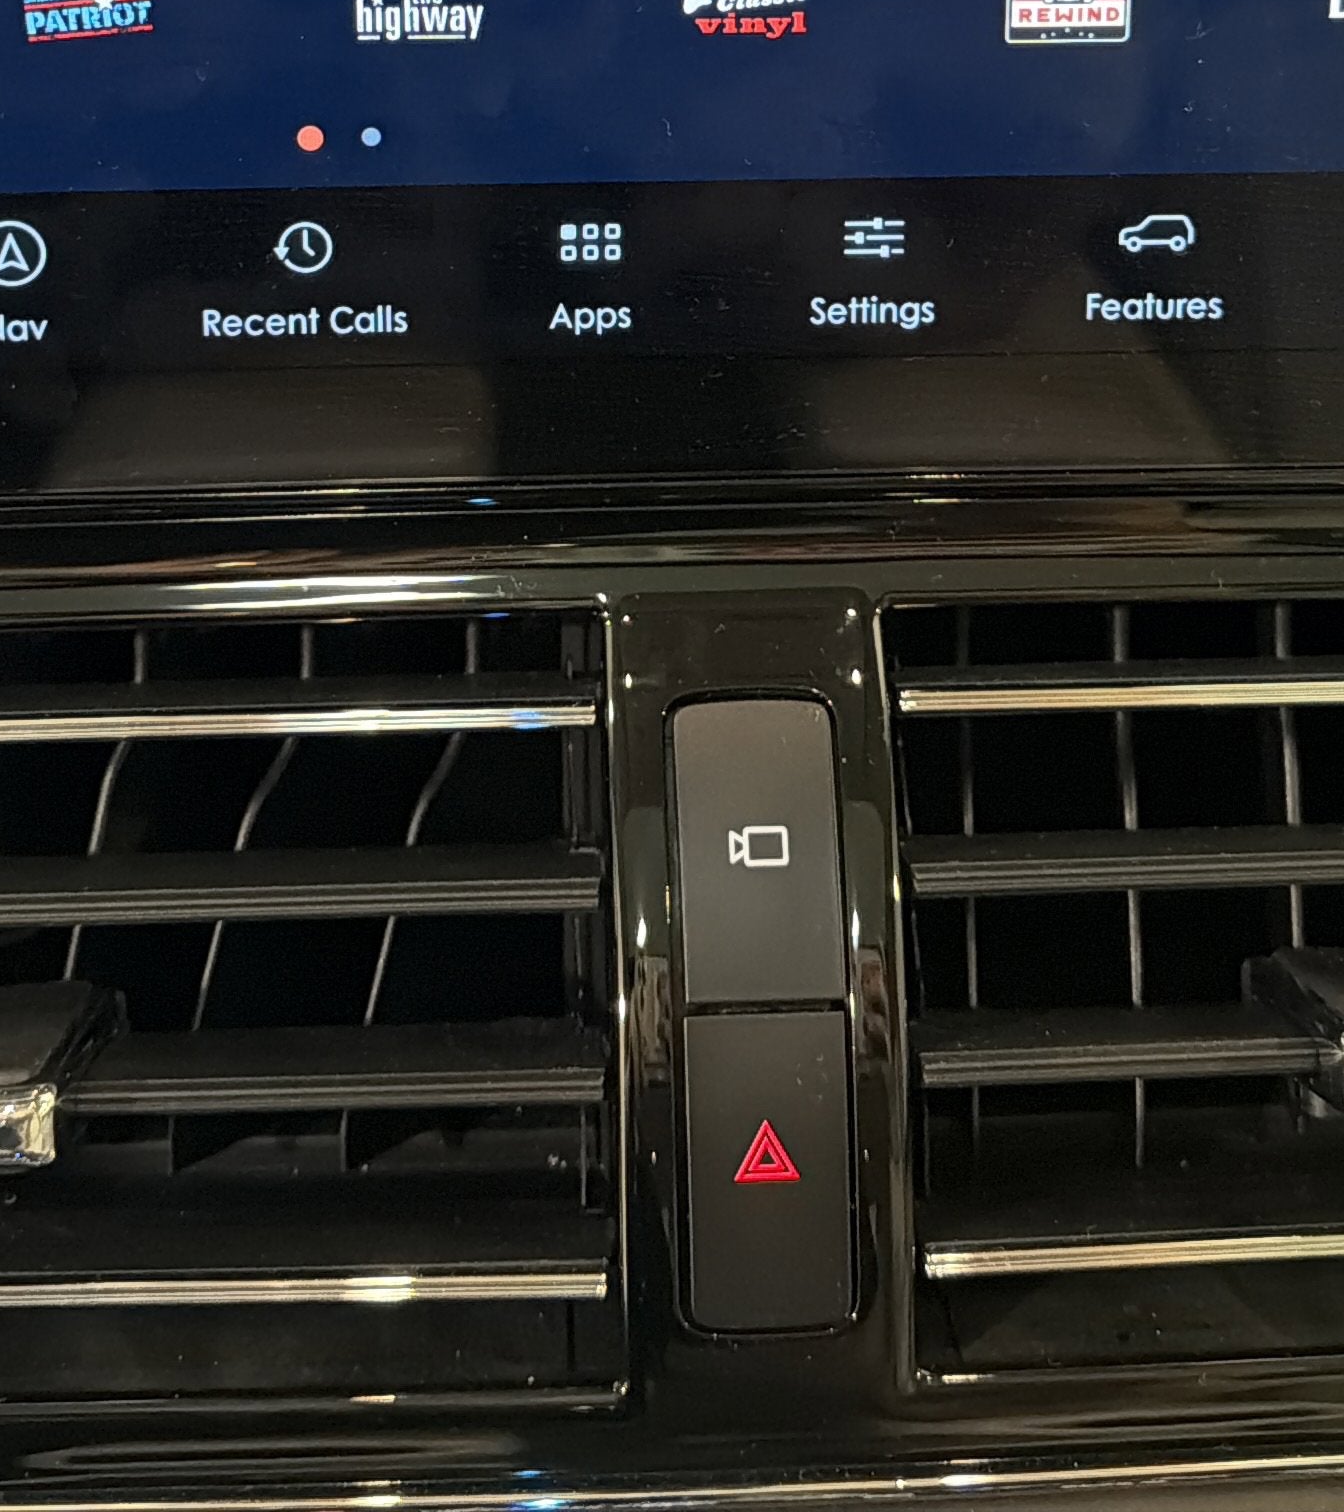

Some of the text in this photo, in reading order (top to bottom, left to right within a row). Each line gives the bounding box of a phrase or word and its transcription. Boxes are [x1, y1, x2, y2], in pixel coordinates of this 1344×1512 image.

[25, 0, 151, 35] PATRIOT
[695, 11, 807, 39] vinyl
[1018, 7, 1120, 23] REWIND
[202, 304, 409, 337] Recent Calls
[548, 302, 632, 336] Apps
[809, 295, 935, 330] Settings
[1085, 292, 1223, 321] Features
